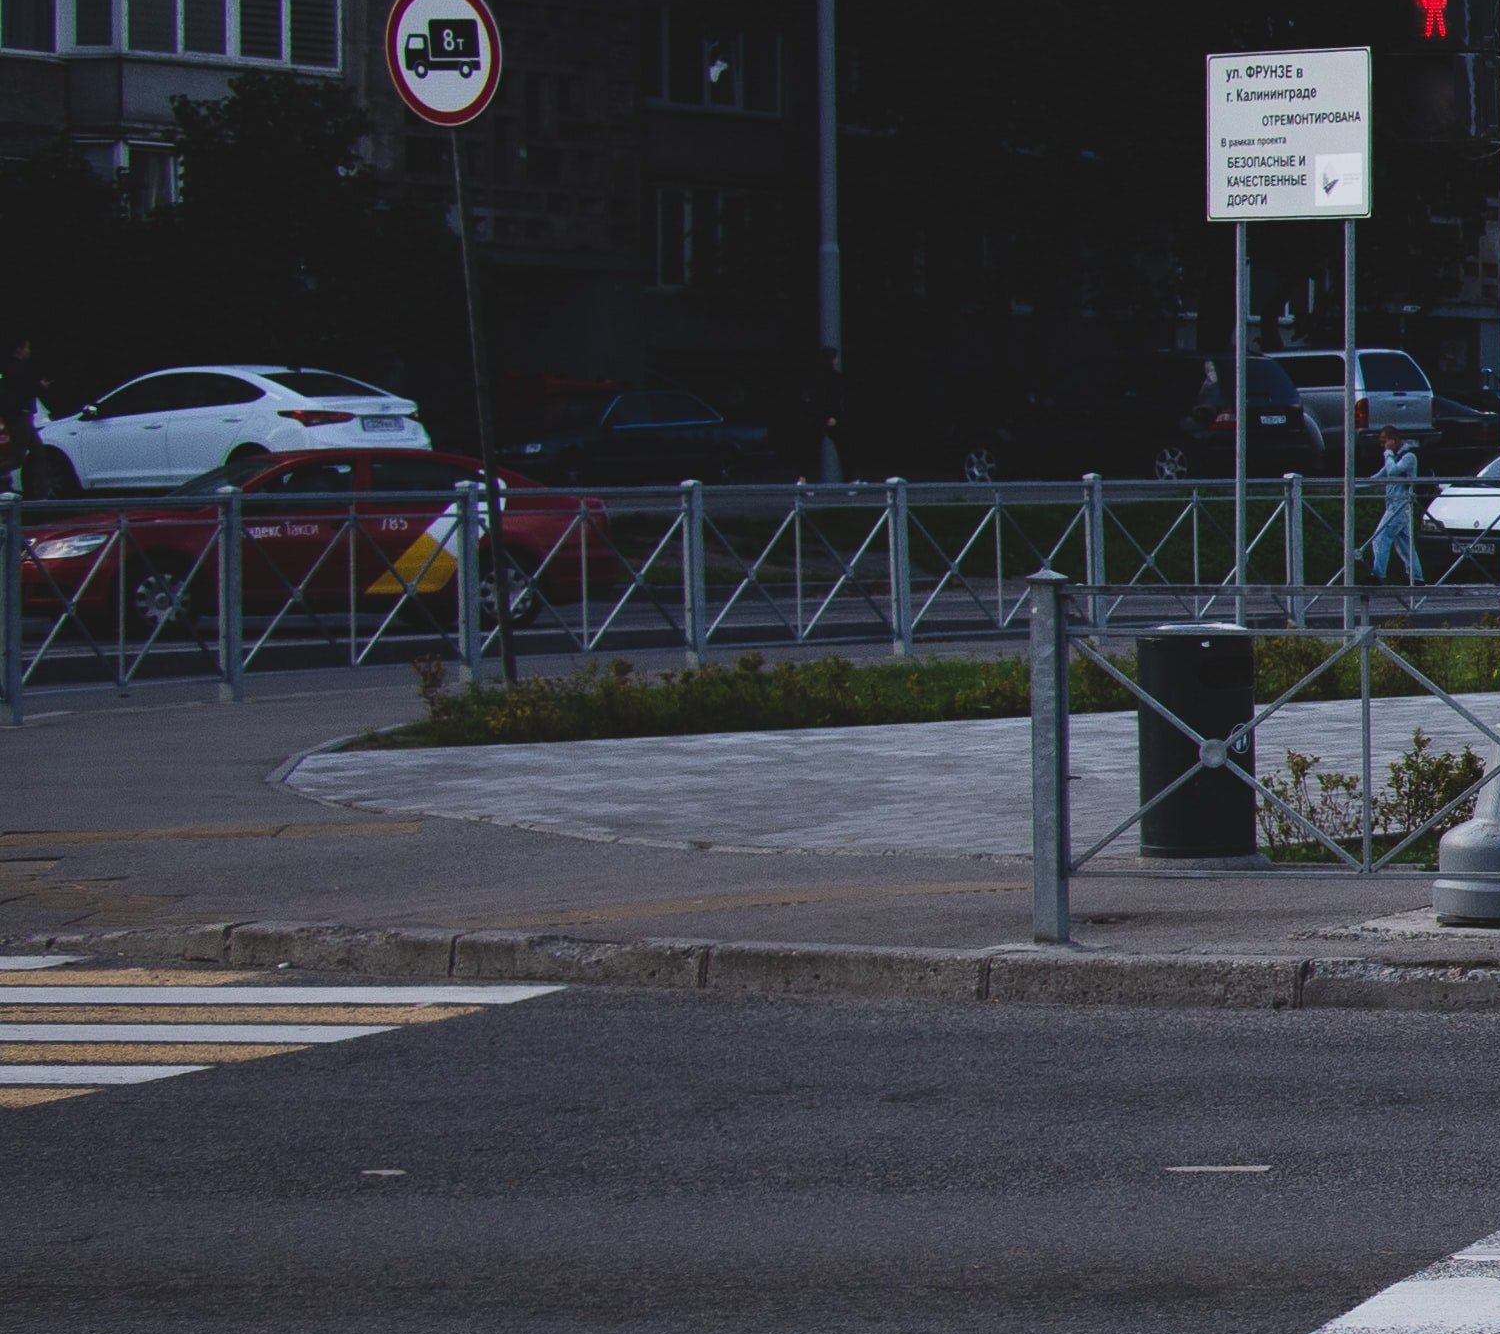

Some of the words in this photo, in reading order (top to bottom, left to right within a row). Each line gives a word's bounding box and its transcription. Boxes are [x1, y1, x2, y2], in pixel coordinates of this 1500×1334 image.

[1226, 68, 1242, 83] ул.
[1246, 64, 1293, 78] ФРУНЗЕ
[1296, 68, 1304, 78] в
[1227, 92, 1233, 102] г.
[1236, 87, 1317, 102] Калининграде
[1262, 111, 1361, 126] ОТРЕМОНТИРОВАНА
[1221, 138, 1227, 147] В
[1229, 137, 1255, 149] рамках
[1257, 136, 1287, 147] проекта
[1226, 155, 1297, 169] БЕЗОПАСНЫЕ
[1298, 154, 1307, 168] И
[1226, 173, 1308, 188] КАЧЕСТВЕННЫЕ
[1226, 193, 1268, 208] ДОРОГИ
[285, 521, 320, 536] Такси
